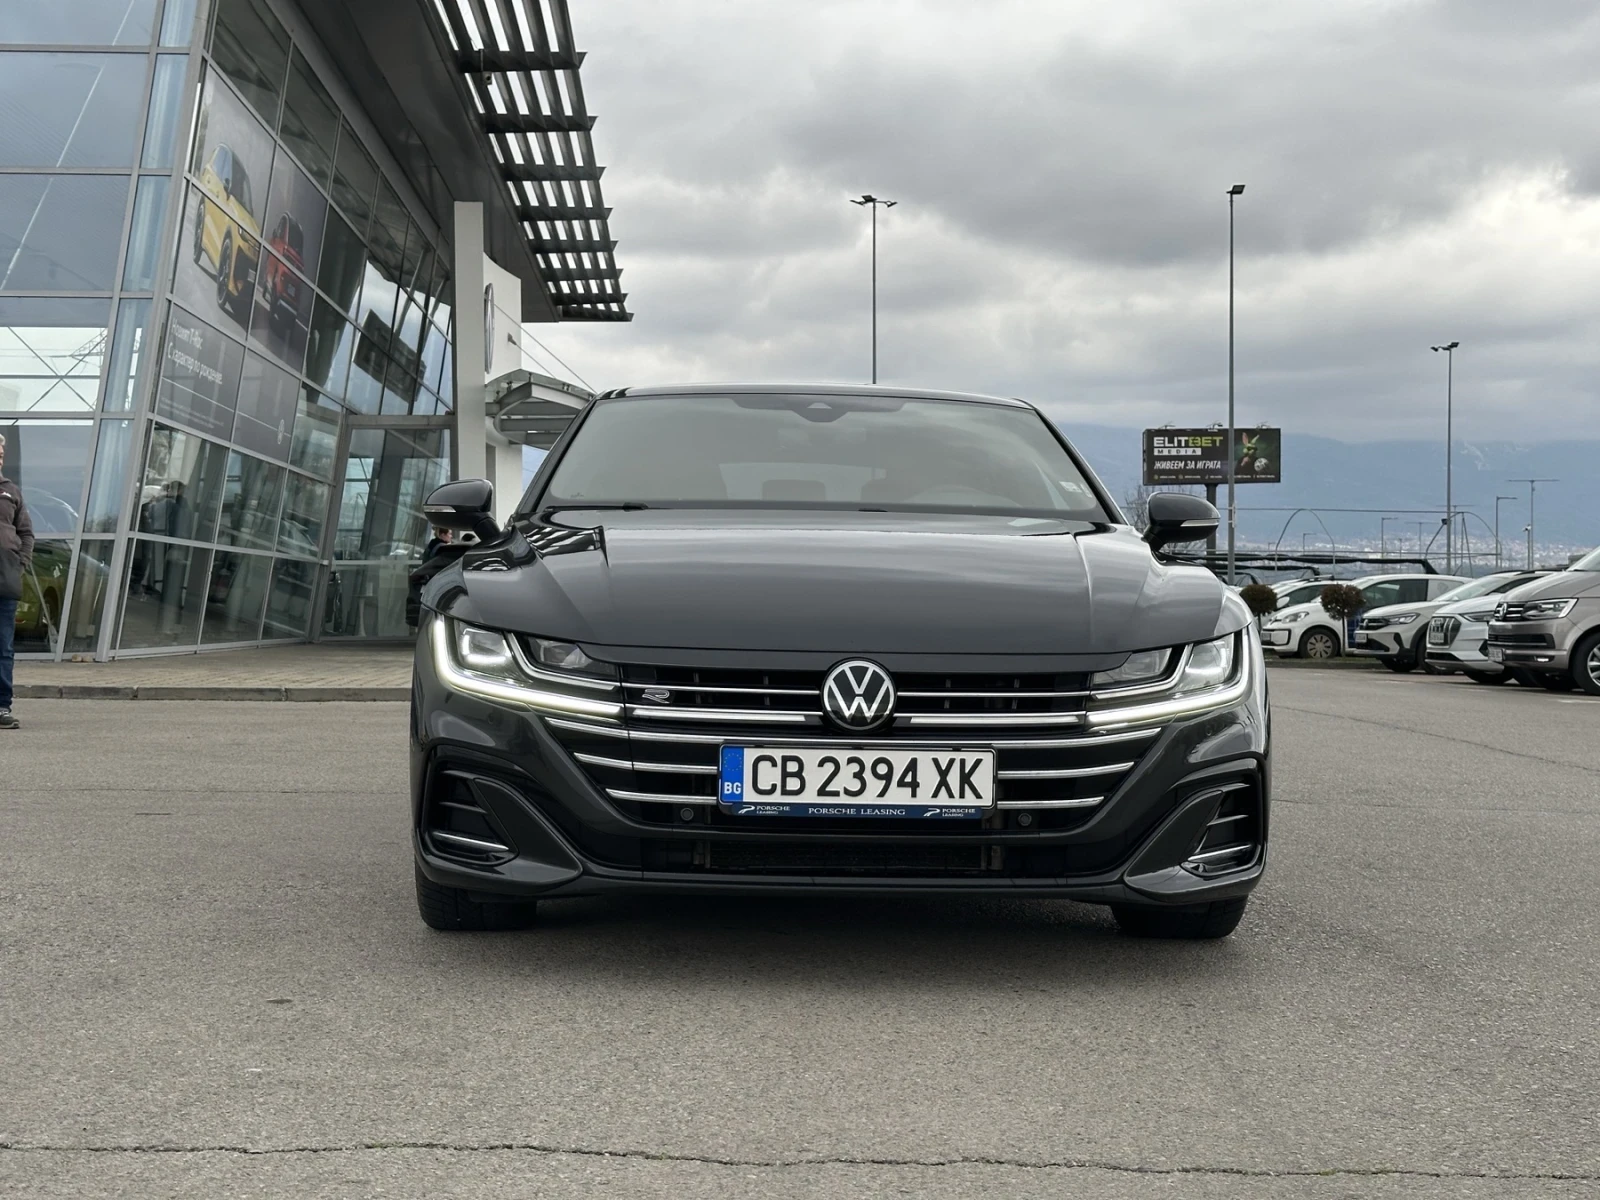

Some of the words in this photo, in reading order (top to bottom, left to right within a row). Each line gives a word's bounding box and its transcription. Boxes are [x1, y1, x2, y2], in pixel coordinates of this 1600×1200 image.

[1153, 460, 1185, 470] ЖИВЕЕМ
[1186, 460, 1196, 469] ЗА
[1196, 460, 1221, 469] ИГРАТА
[752, 754, 806, 796] CB
[816, 755, 920, 798] 2394
[931, 757, 984, 799] XK
[724, 782, 742, 795] BG
[808, 807, 857, 815] PORSCHE
[860, 808, 906, 816] LEASING
